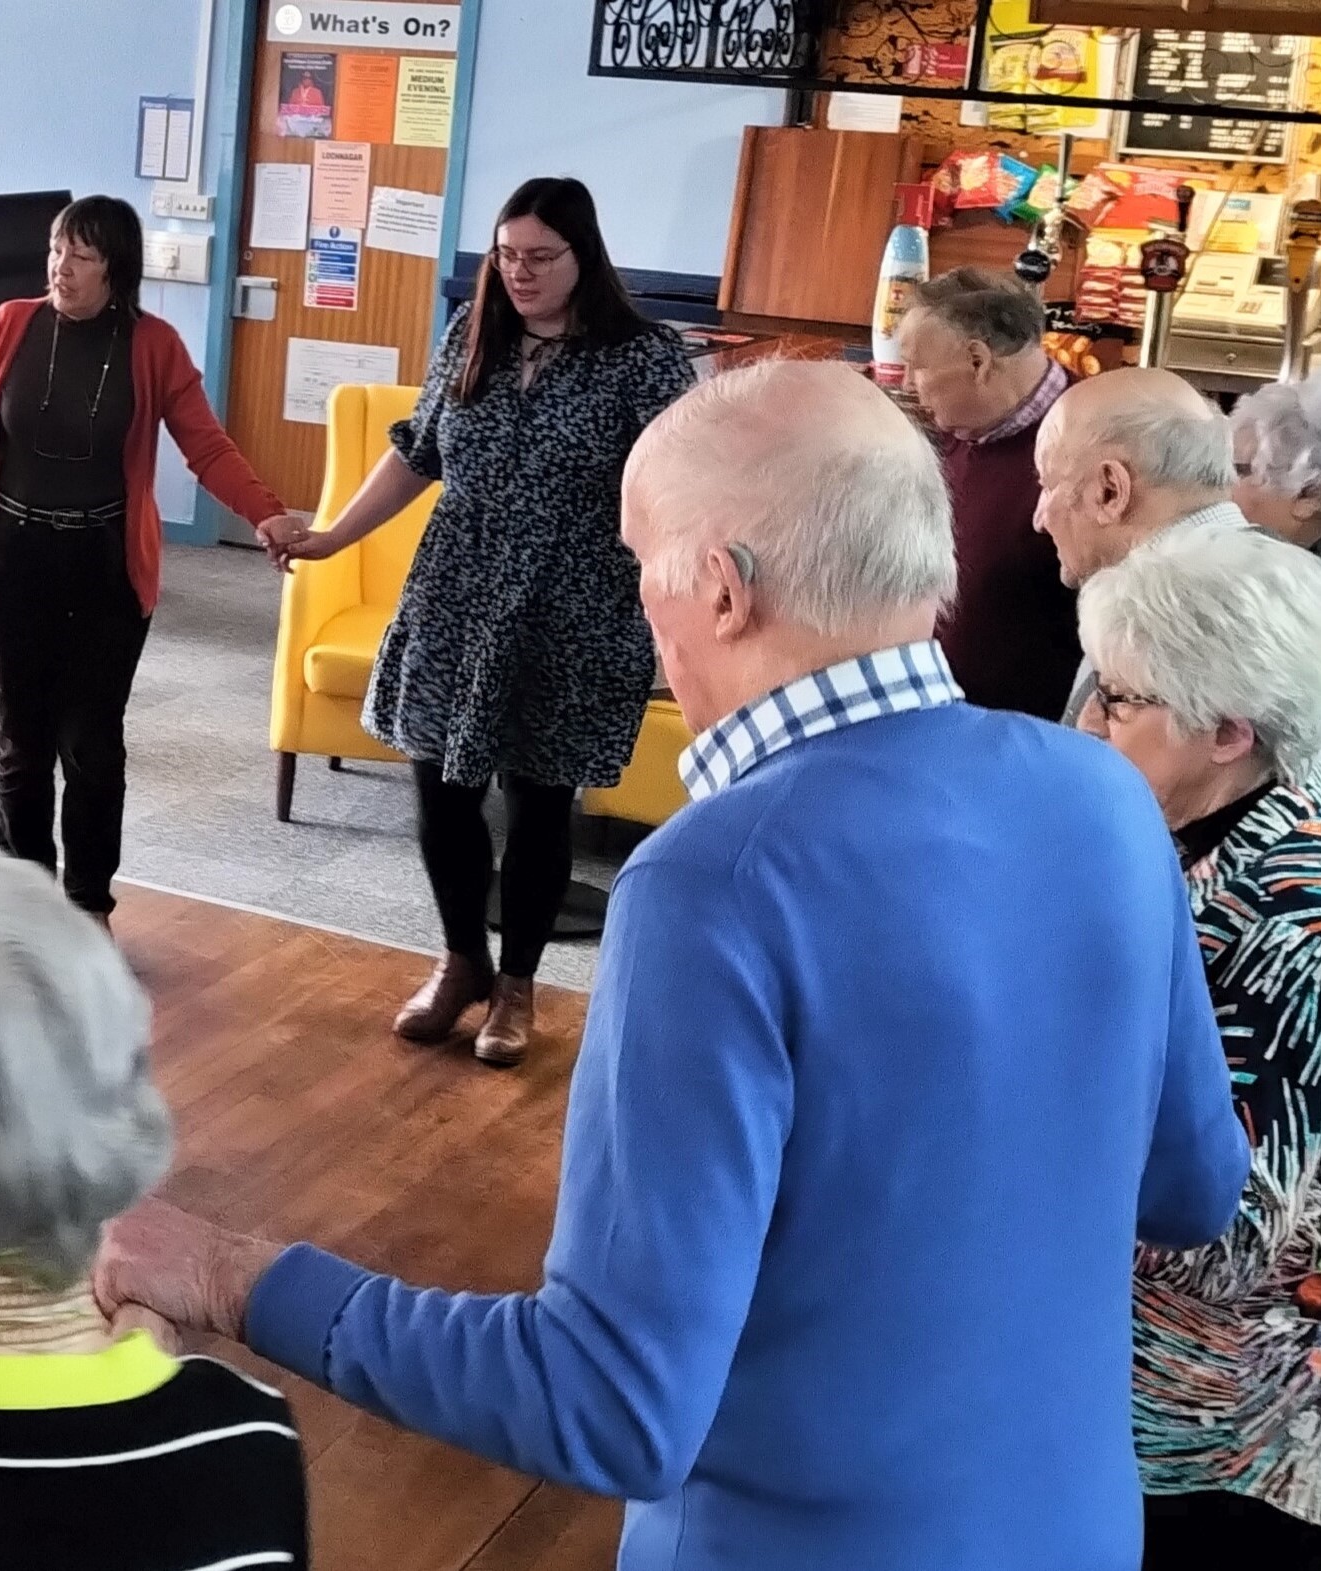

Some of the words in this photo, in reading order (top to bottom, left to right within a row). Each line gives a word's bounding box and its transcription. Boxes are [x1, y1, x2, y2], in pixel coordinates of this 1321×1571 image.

[309, 13, 390, 35] What's
[403, 17, 451, 38] On?
[410, 75, 445, 84] MEDIUM
[407, 84, 446, 93] EVENING
[321, 152, 363, 161] LOCHNAGAR
[313, 241, 329, 249] Fire
